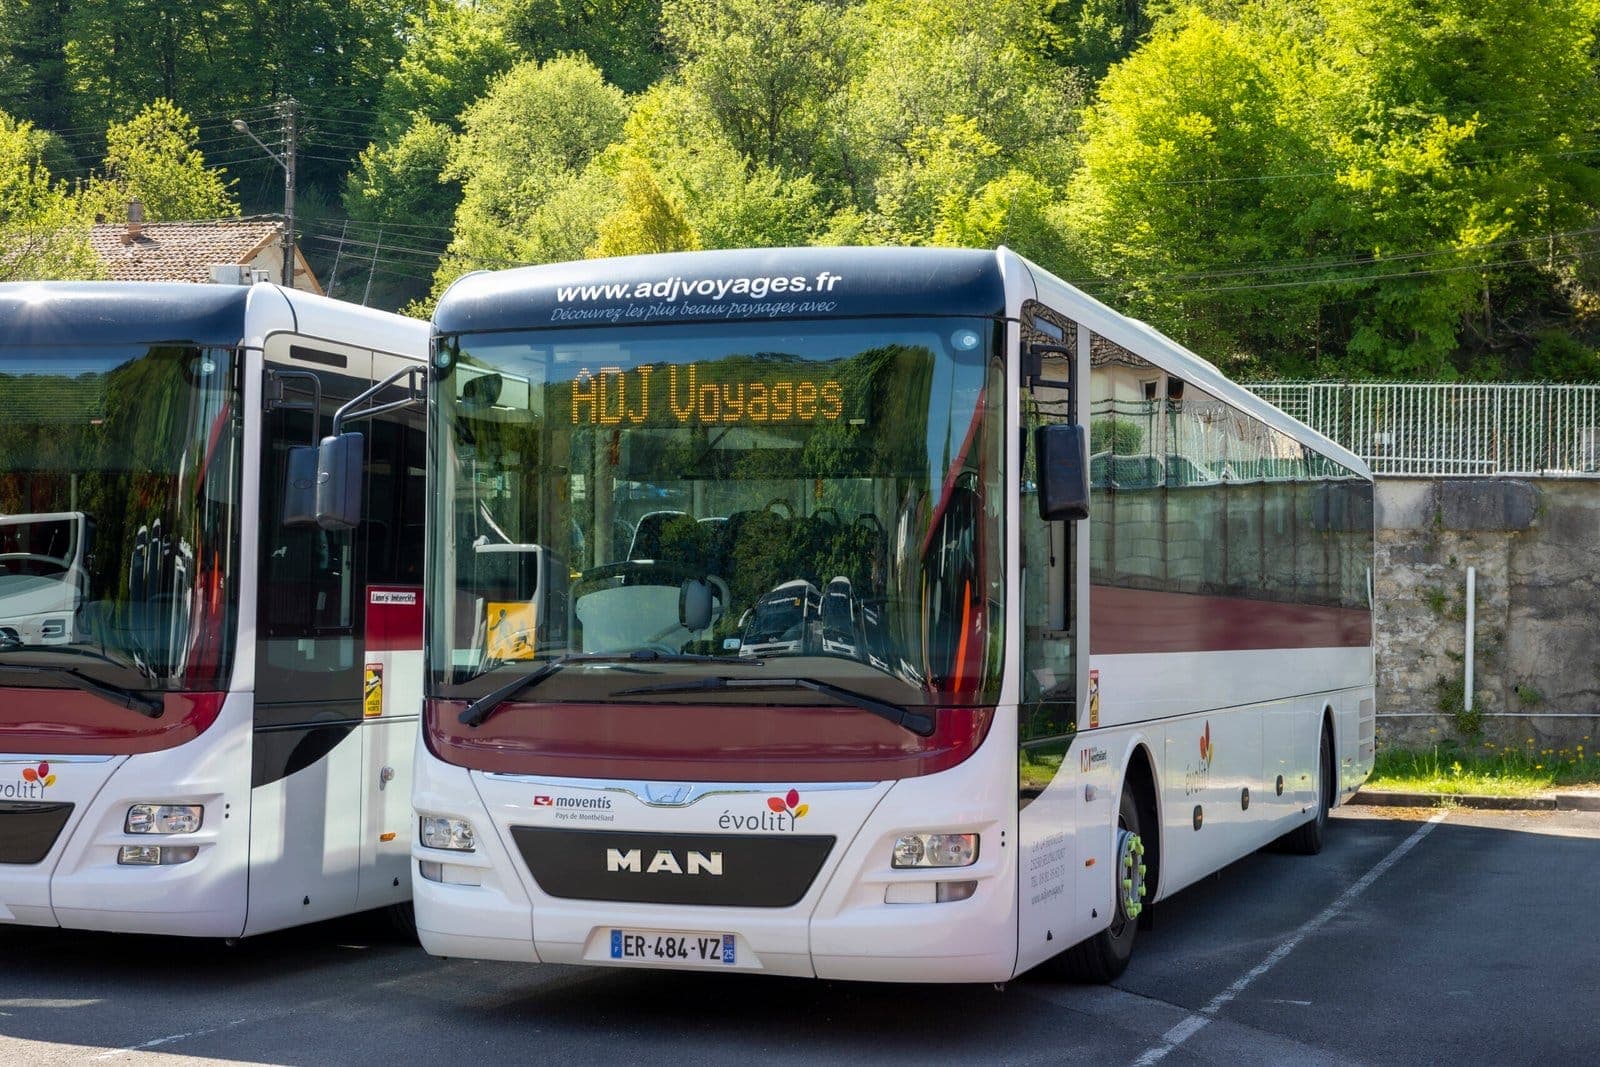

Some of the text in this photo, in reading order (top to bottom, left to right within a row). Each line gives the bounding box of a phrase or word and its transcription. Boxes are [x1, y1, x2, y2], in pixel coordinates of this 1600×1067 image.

[556, 271, 842, 302] www.adjvoyages.fr
[550, 300, 838, 323] Découvrez les plus beaux paysages avec
[571, 364, 843, 425] ADJ Voyages
[556, 796, 611, 809] moventis
[607, 848, 724, 876] MAN
[624, 935, 721, 960] ER-484-VZ
[724, 949, 734, 960] 25
